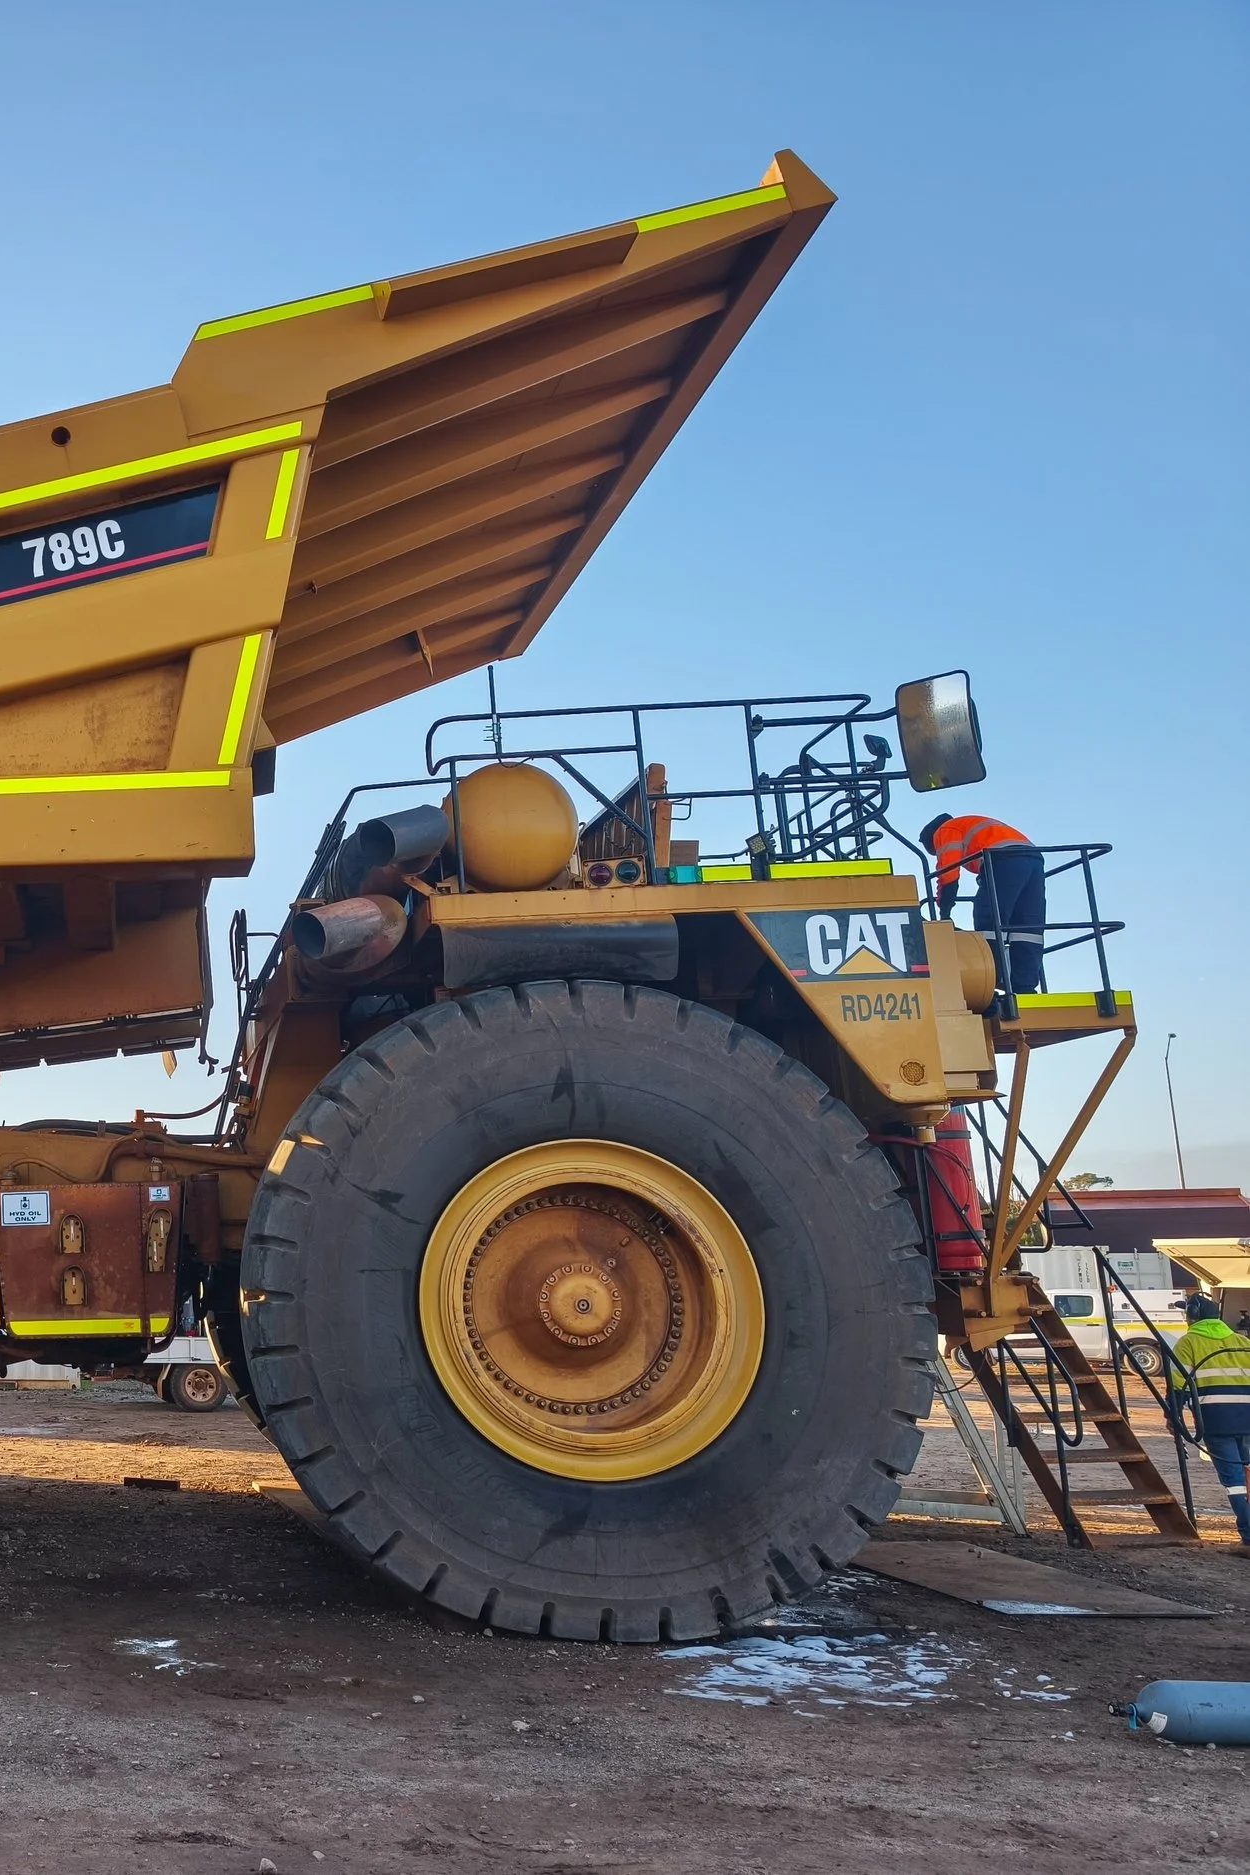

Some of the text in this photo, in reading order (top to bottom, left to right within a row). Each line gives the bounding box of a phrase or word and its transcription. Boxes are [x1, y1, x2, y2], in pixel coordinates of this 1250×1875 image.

[21, 519, 126, 578] 789C
[805, 912, 911, 976] CAT
[841, 992, 922, 1022] RD4241
